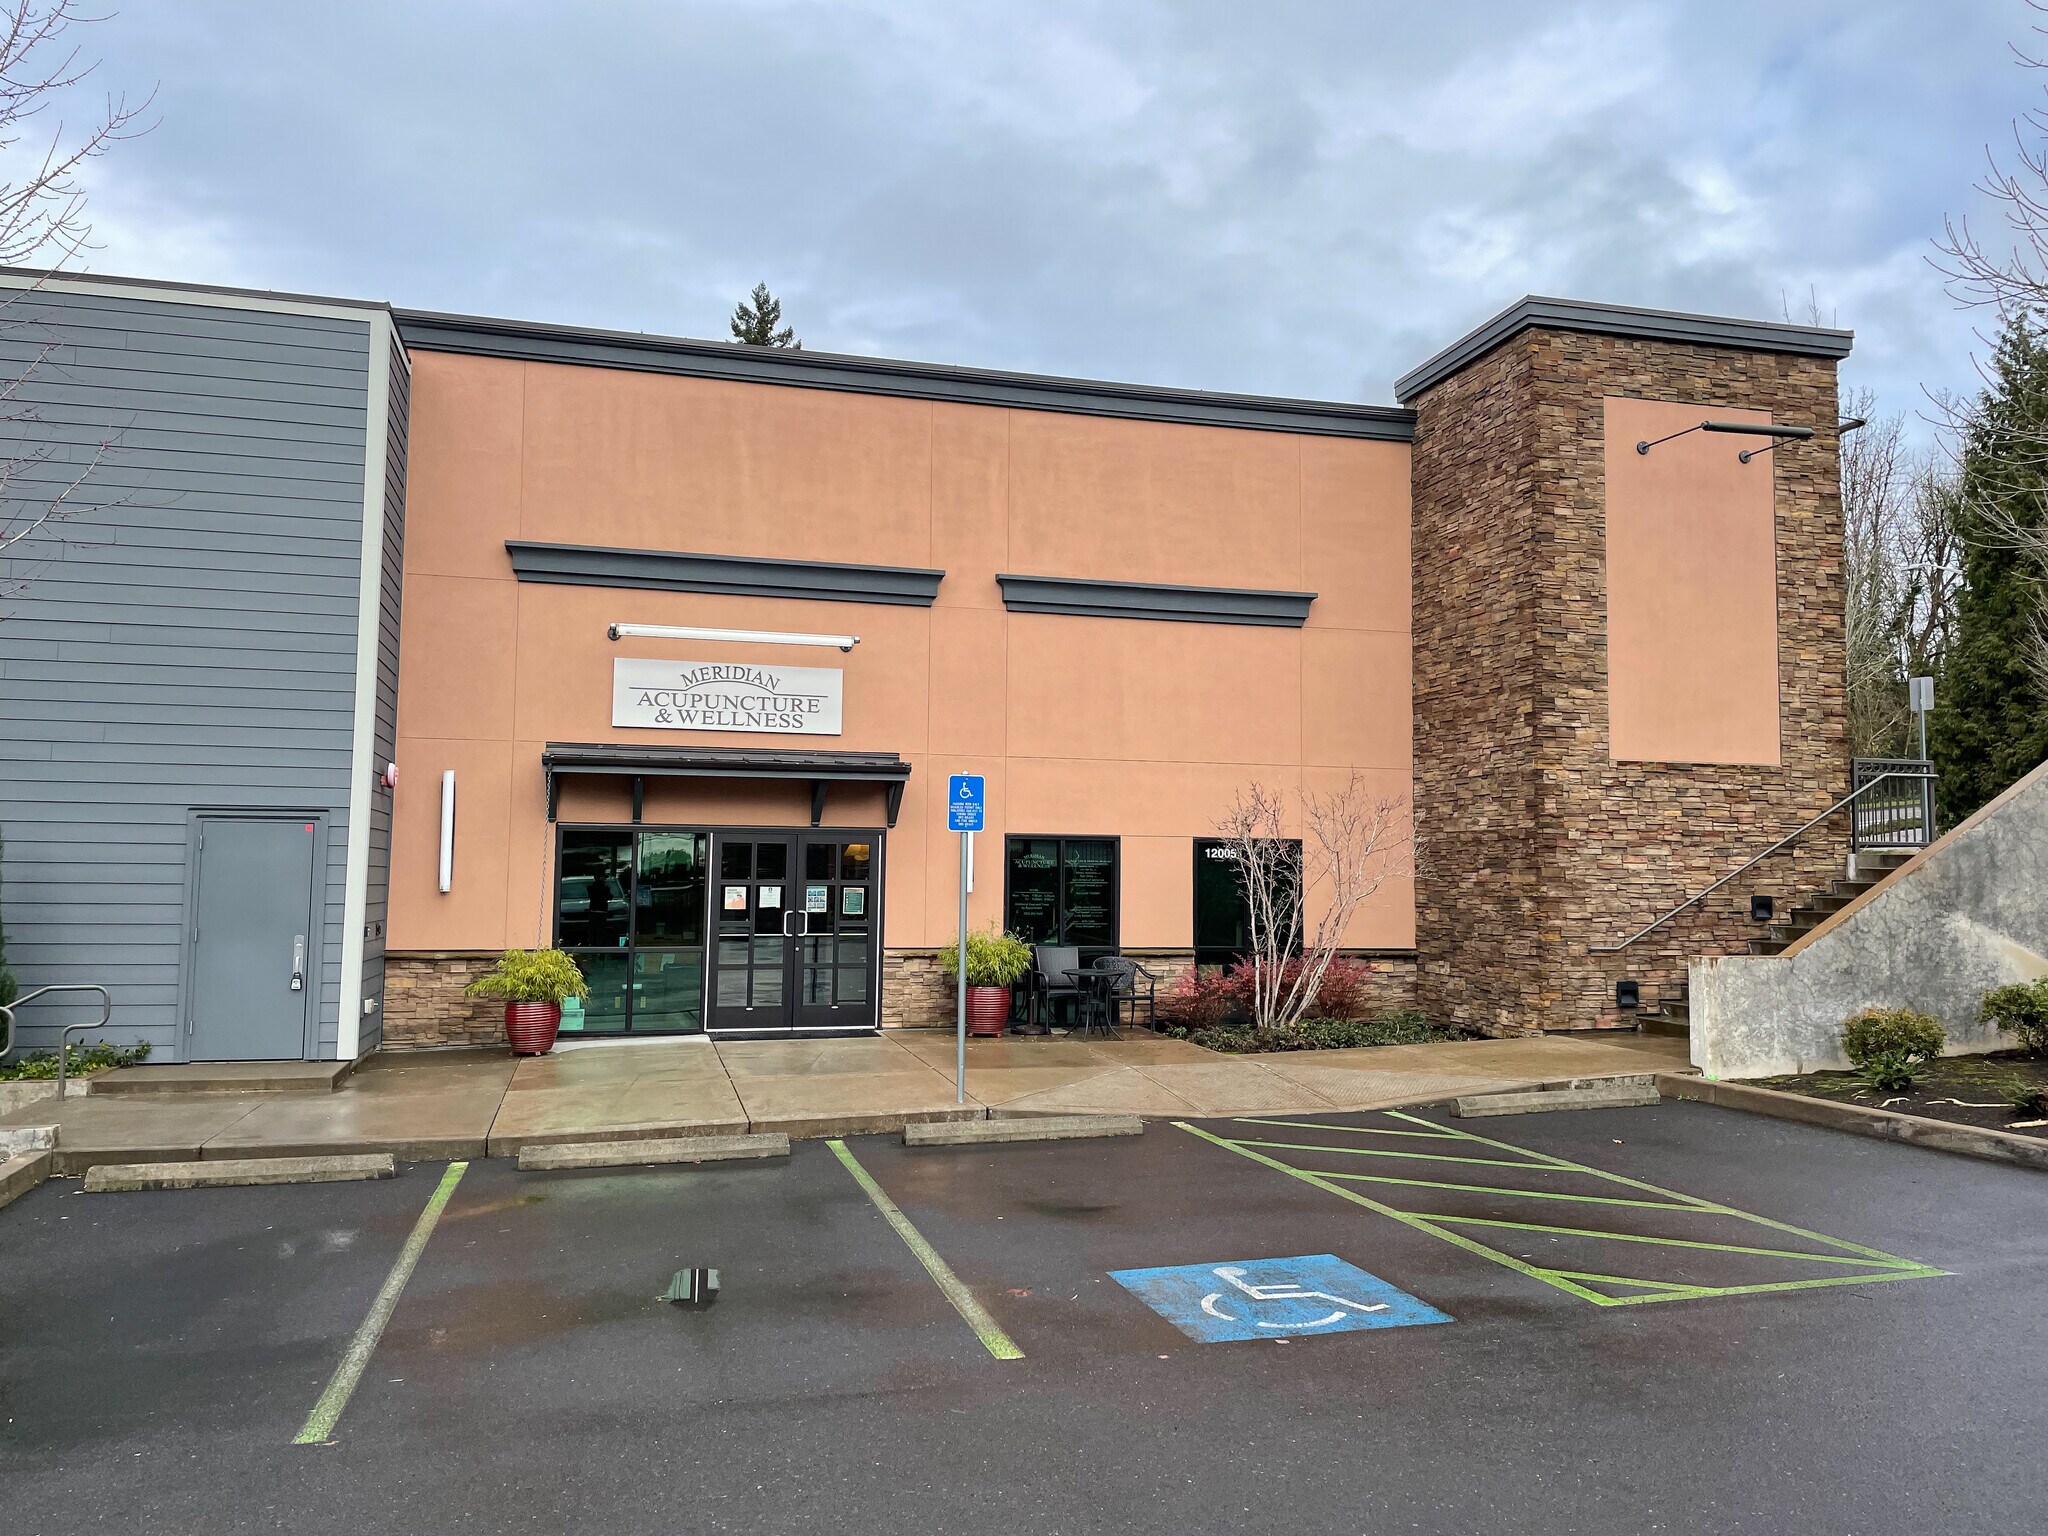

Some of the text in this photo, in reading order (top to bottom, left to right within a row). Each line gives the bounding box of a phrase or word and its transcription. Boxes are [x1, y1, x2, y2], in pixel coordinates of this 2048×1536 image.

[680, 665, 781, 691] MERIDIAN
[637, 691, 821, 714] ACUPUNCTURE
[654, 708, 804, 729] & WELLNESS
[1205, 848, 1237, 859] 12005
